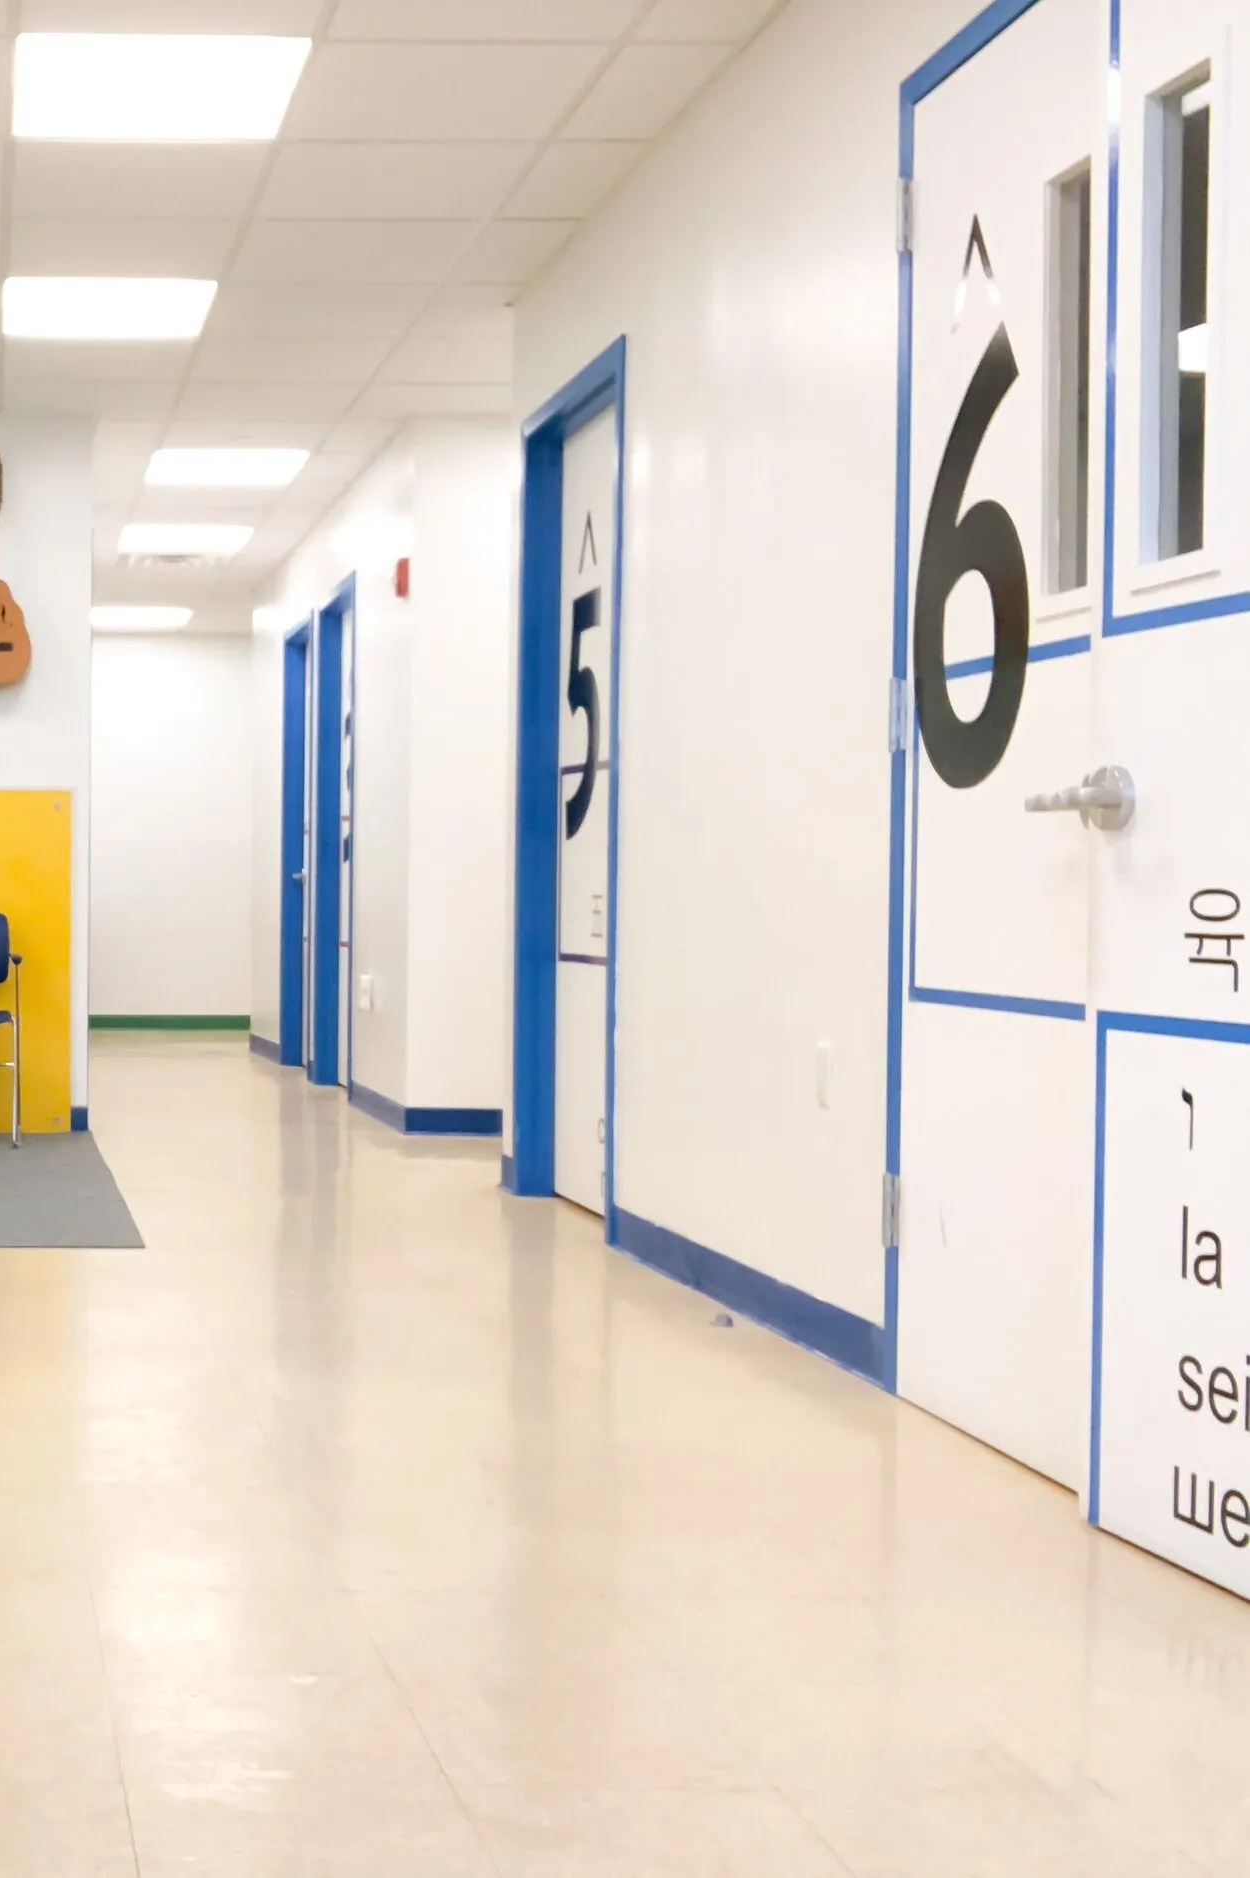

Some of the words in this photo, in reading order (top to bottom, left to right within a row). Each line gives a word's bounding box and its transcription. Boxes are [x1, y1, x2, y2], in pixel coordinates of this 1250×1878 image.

[914, 320, 1030, 789] 6
[566, 585, 601, 840] 5
[1184, 888, 1245, 993] 육
[1181, 1205, 1223, 1289] la
